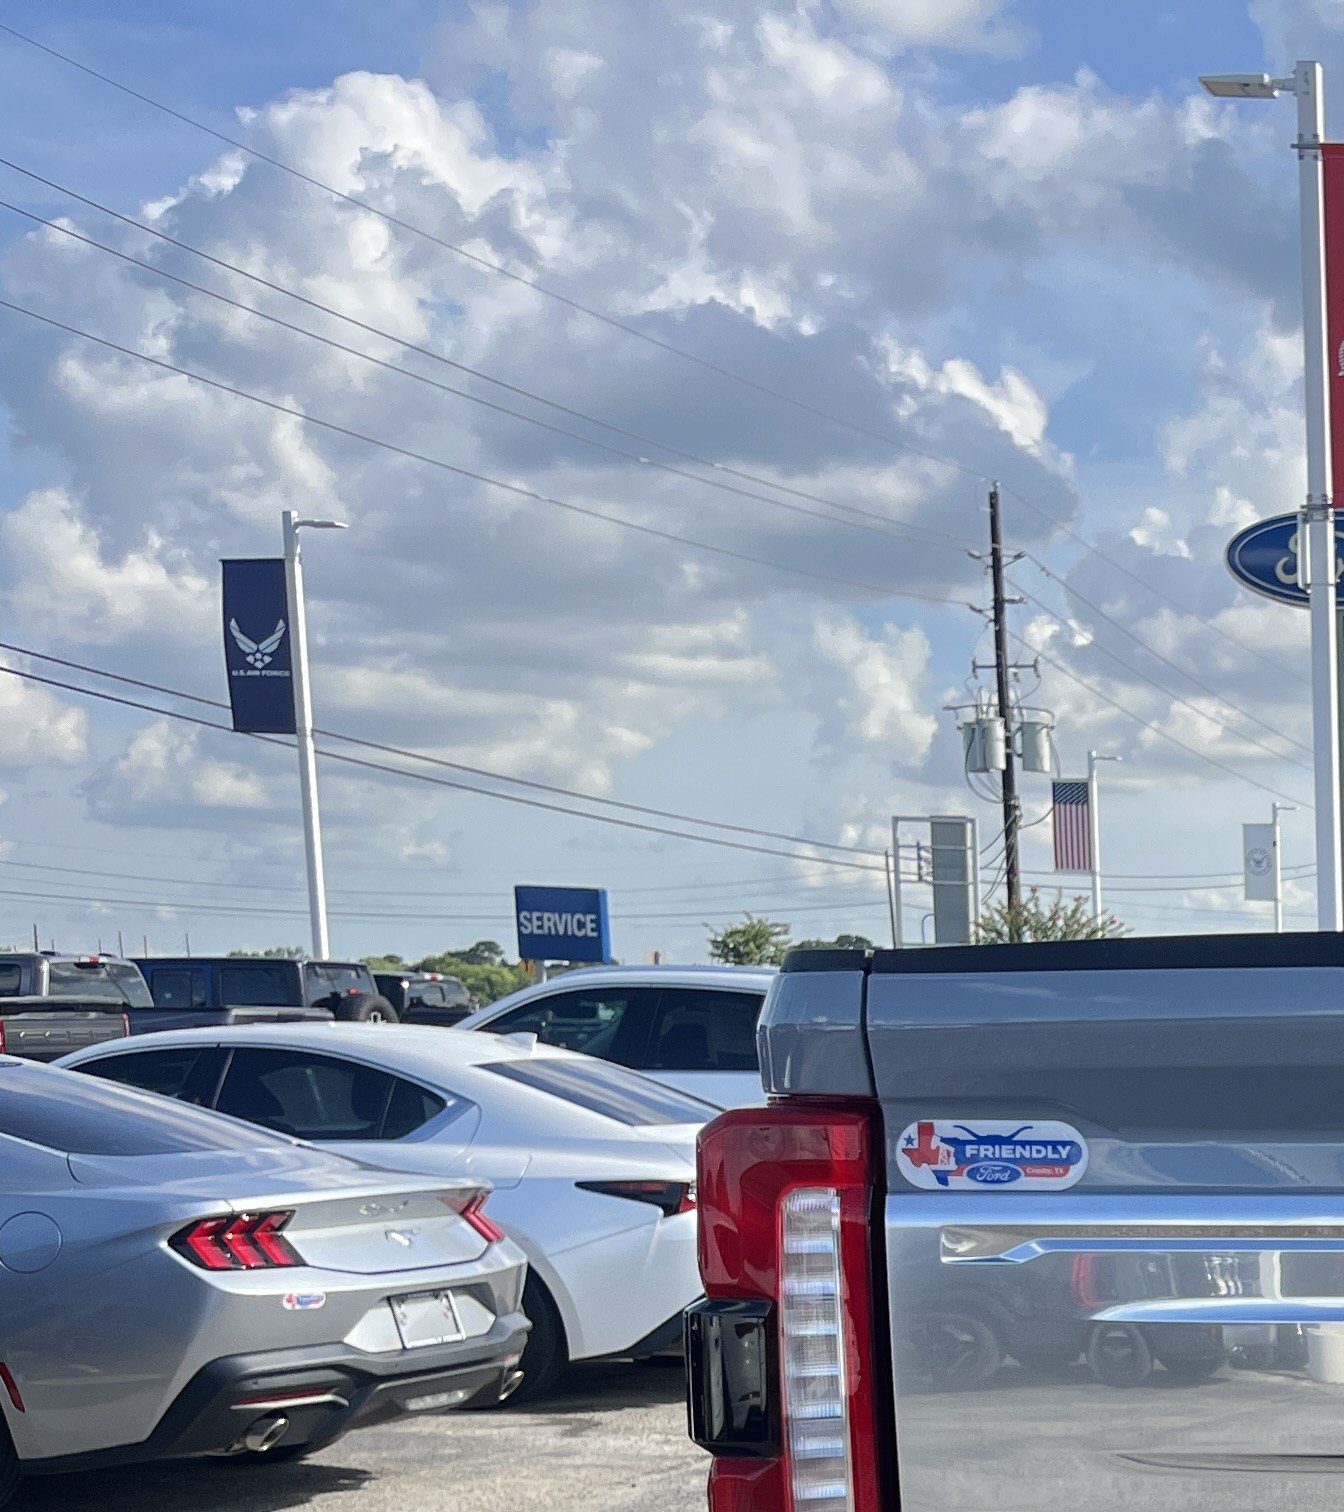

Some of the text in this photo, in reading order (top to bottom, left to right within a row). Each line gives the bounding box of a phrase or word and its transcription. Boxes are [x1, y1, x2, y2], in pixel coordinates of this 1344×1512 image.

[519, 910, 599, 938] SERVICE
[965, 1144, 1072, 1160] FRIENDLY
[975, 1165, 1010, 1182] Ford
